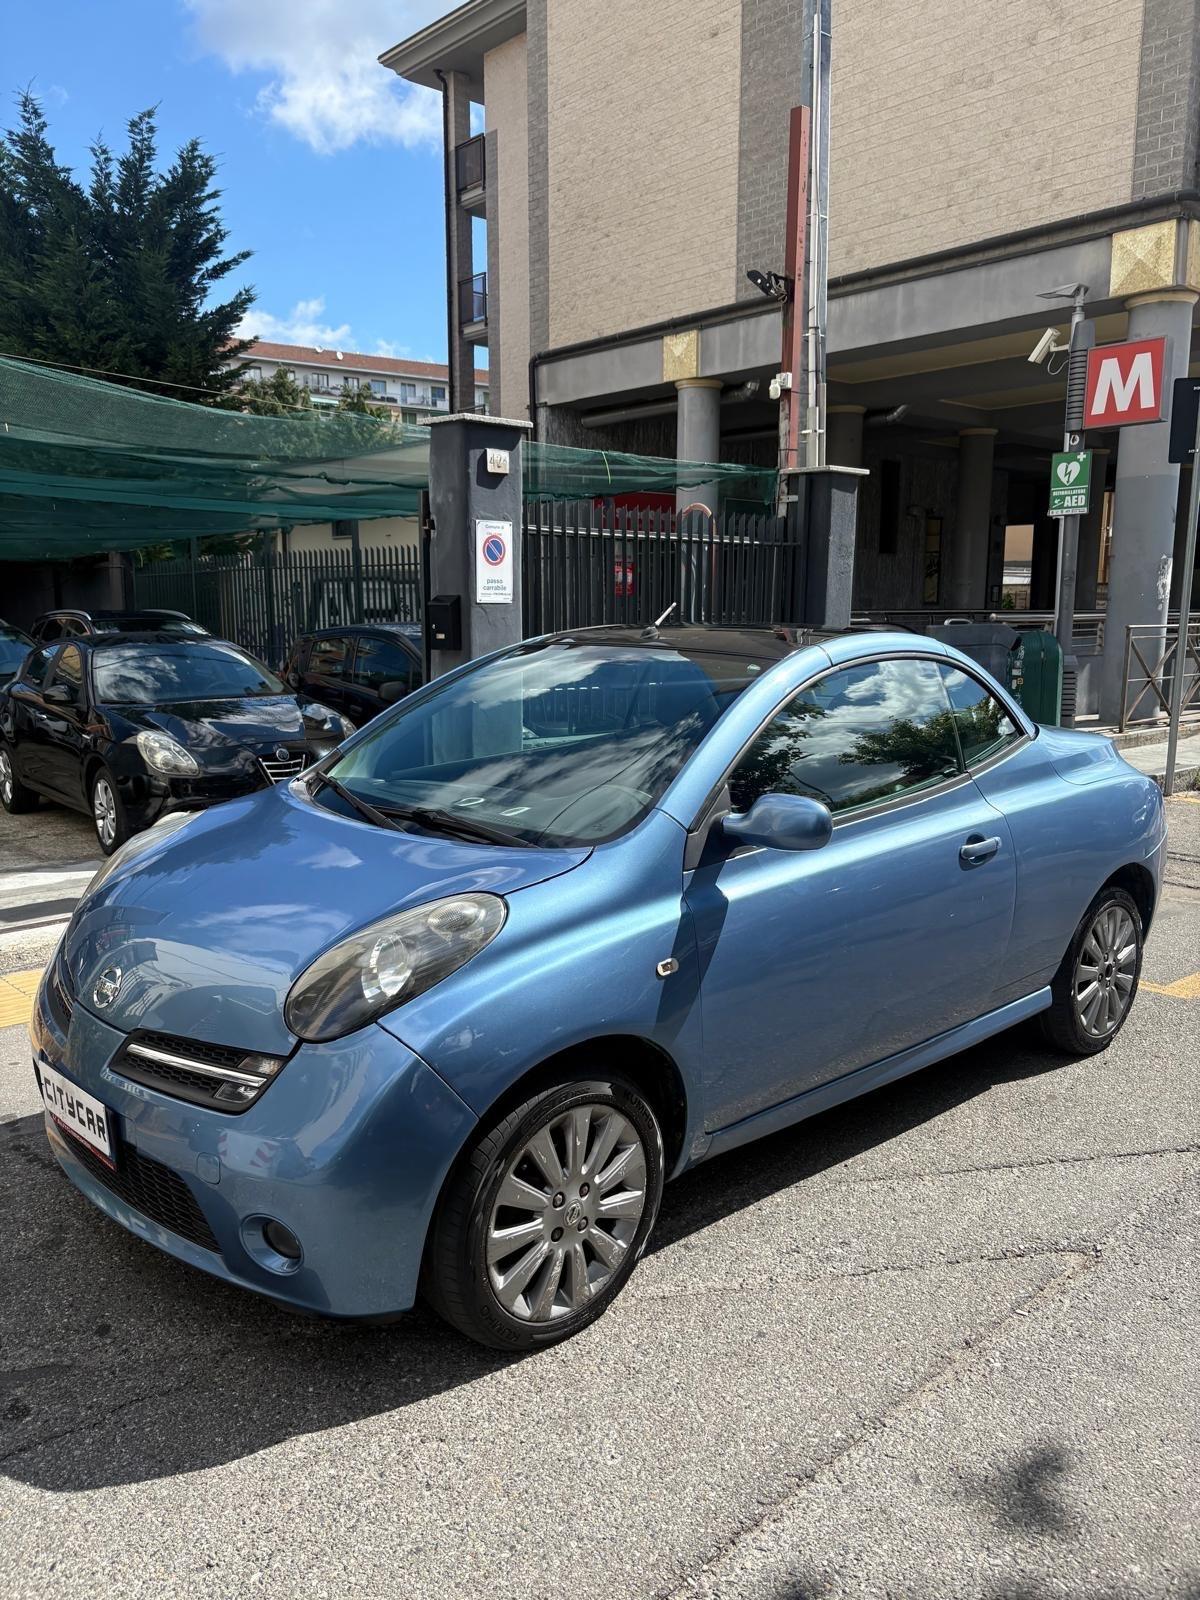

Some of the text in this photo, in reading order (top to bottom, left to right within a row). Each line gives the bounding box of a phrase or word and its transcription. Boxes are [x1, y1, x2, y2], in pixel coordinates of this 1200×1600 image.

[1091, 352, 1155, 415] M
[1064, 495, 1086, 507] AED
[44, 1076, 107, 1142] CITYCAR
